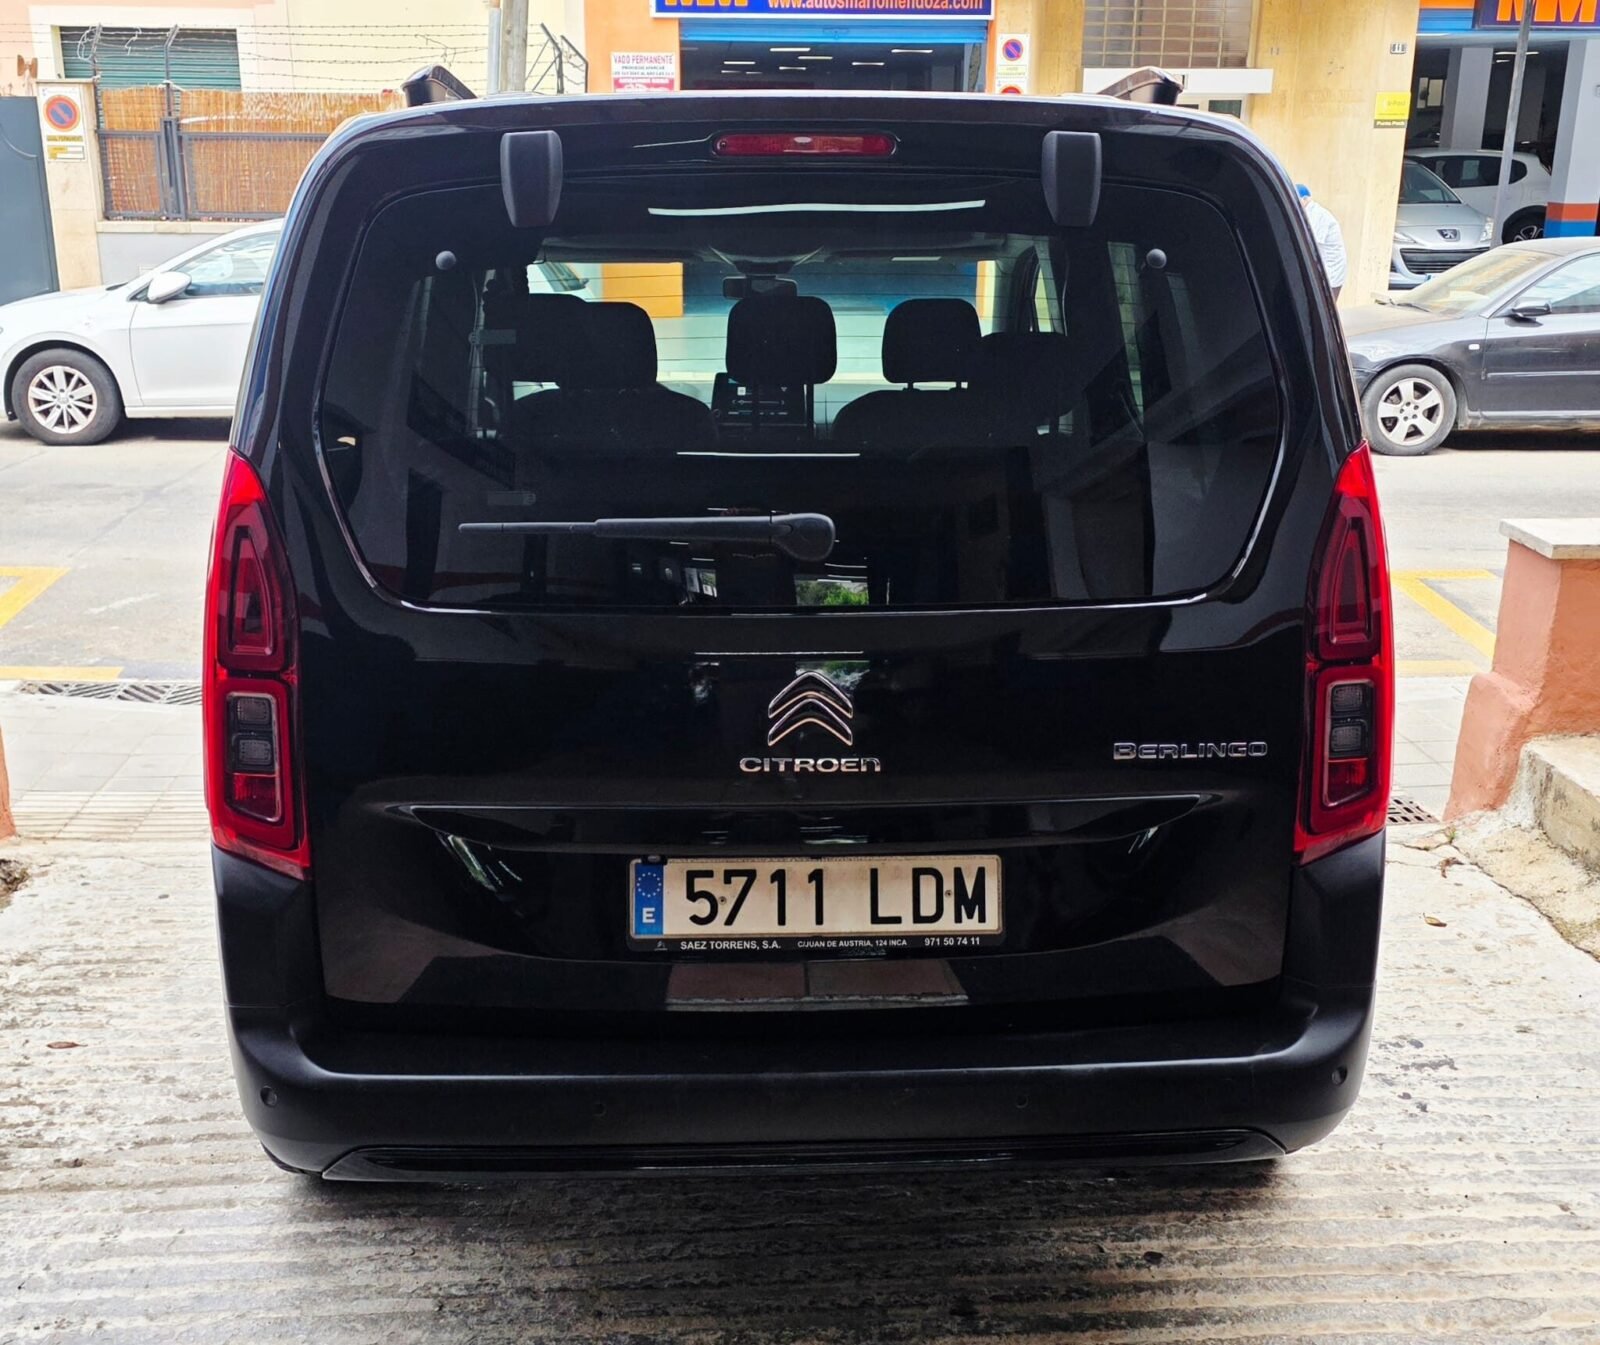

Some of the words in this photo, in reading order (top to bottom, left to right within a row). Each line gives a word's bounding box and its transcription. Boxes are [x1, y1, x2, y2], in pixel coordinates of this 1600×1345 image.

[613, 54, 631, 64] VADO
[632, 54, 673, 64] PERMANENTE
[1113, 741, 1268, 760] BERLINGO
[739, 757, 881, 773] CITROEN
[685, 869, 824, 927] 5711
[869, 866, 987, 925] LDM
[642, 907, 656, 924] E
[680, 940, 707, 950] SAEZ
[709, 940, 760, 951] TORRENS,
[762, 940, 781, 949] S.A.
[826, 940, 838, 948] DE
[839, 939, 874, 948] AUSTRIA,
[875, 939, 888, 947] 124
[888, 939, 908, 947] INCA
[924, 937, 940, 947] 971
[943, 937, 955, 946] 50
[956, 937, 968, 946] 74
[970, 936, 981, 946] 11
